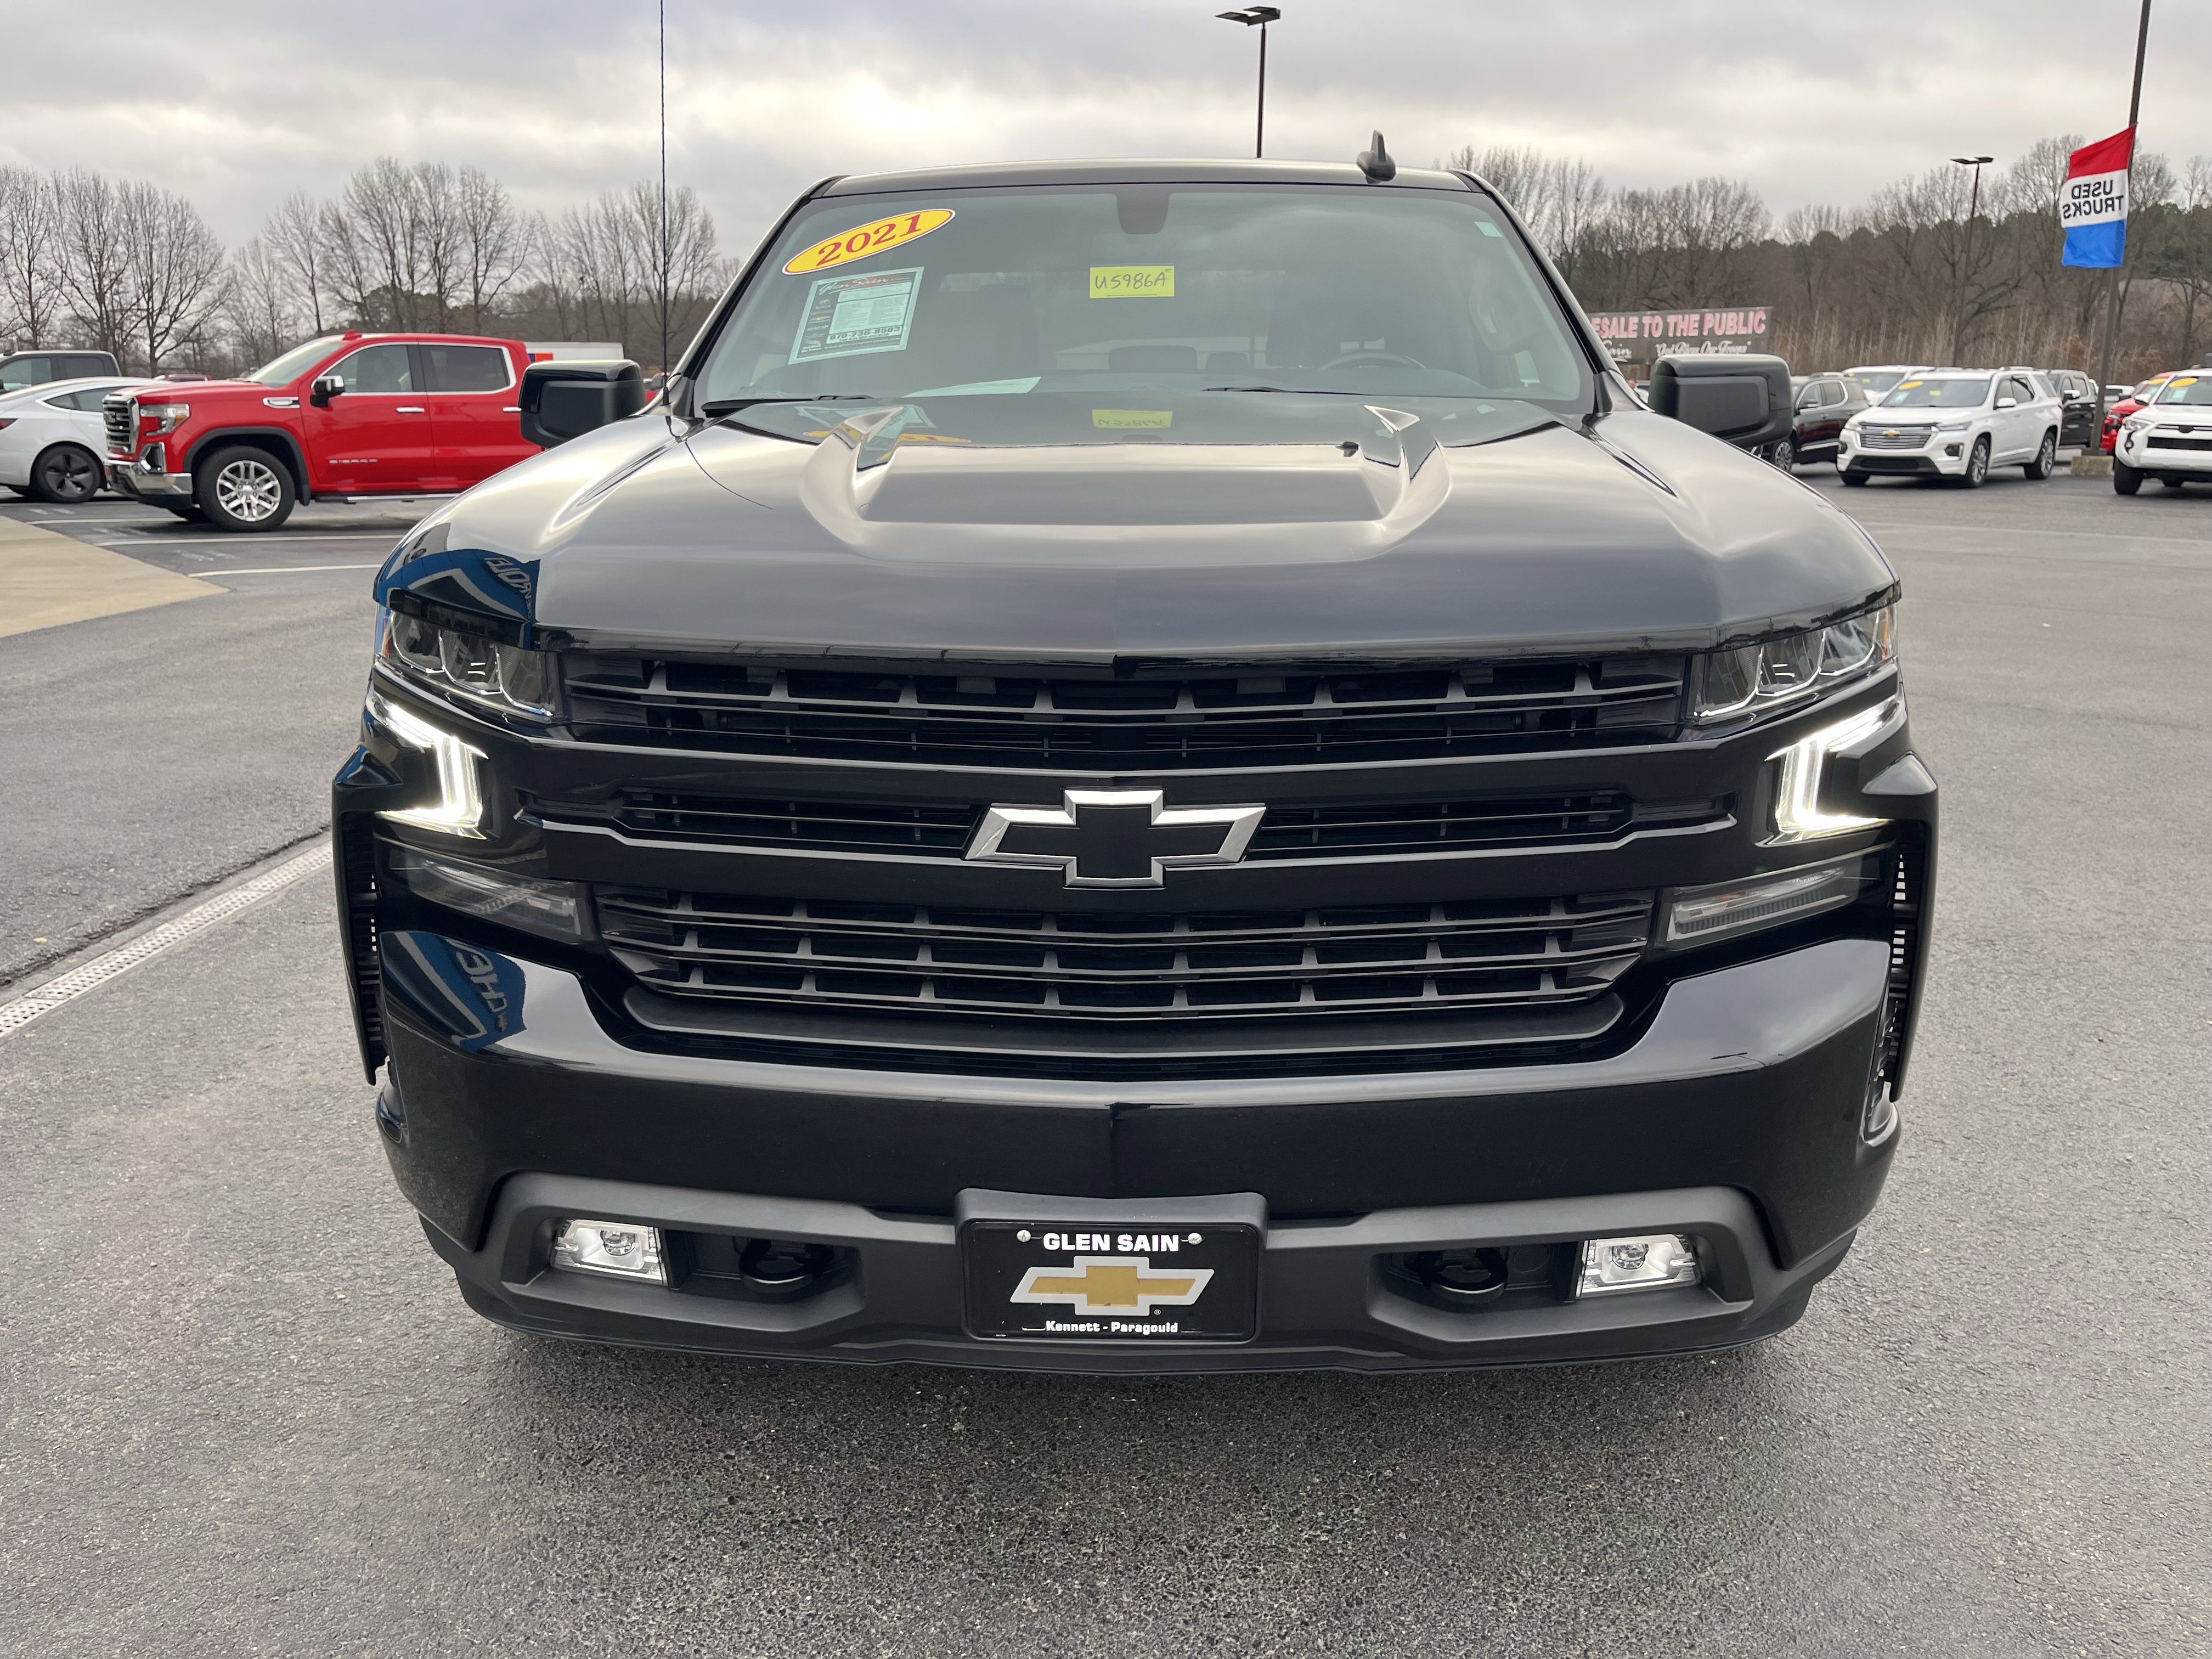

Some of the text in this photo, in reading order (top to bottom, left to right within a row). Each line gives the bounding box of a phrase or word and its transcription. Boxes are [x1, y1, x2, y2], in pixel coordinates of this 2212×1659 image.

[816, 215, 922, 267] 2021
[1641, 315, 1663, 337] TO
[1667, 313, 1700, 337] THE
[1702, 310, 1766, 336] PUBLIC
[1043, 1233, 1179, 1252] GLEN SAIN
[1046, 1321, 1101, 1333] Kennett
[1111, 1322, 1178, 1335] Paragould
